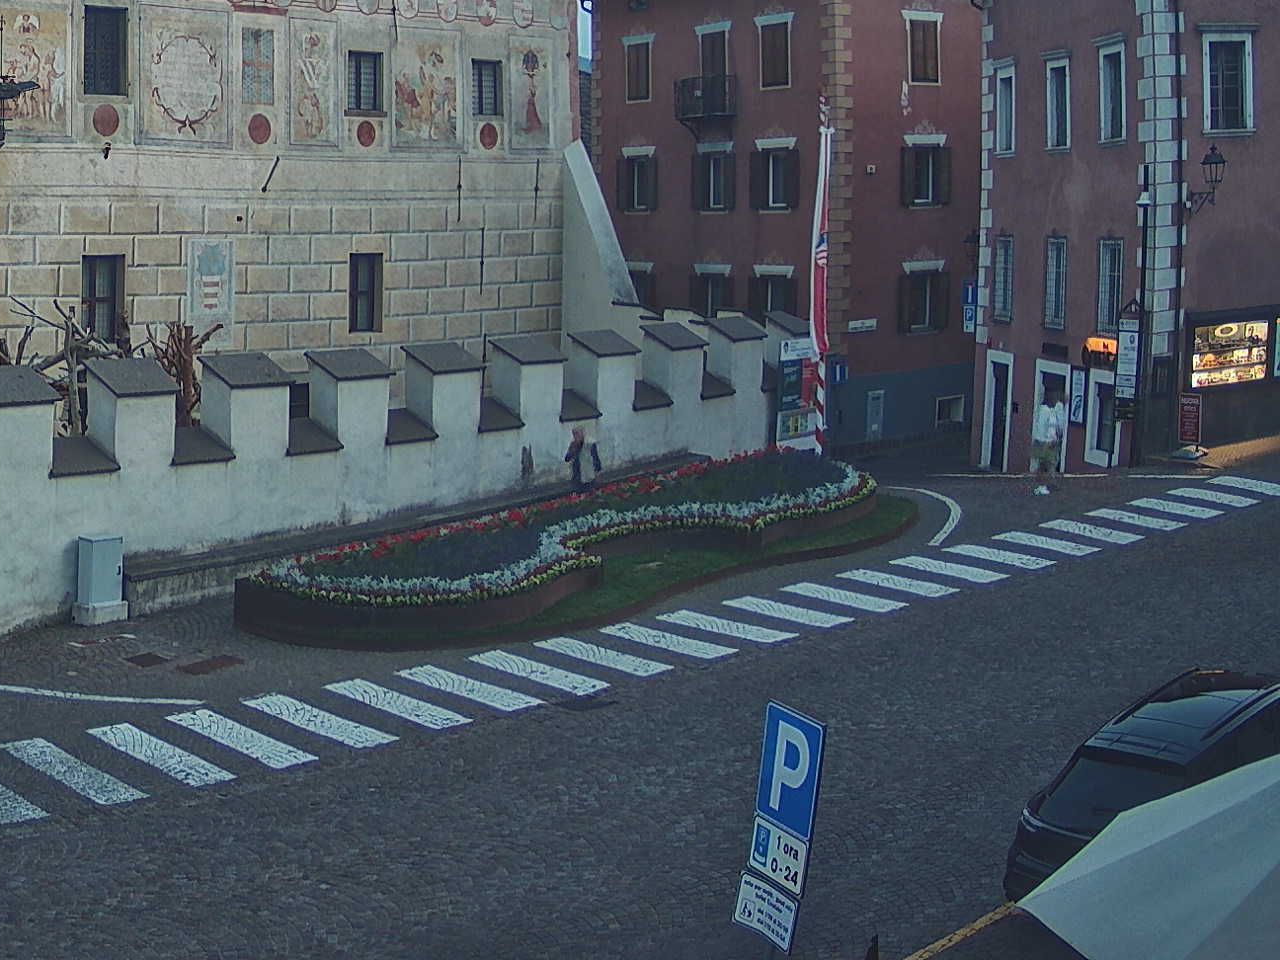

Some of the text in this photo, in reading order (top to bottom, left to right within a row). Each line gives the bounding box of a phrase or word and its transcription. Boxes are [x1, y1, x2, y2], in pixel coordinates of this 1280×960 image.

[769, 720, 809, 811] P
[777, 835, 799, 861] 1 ora
